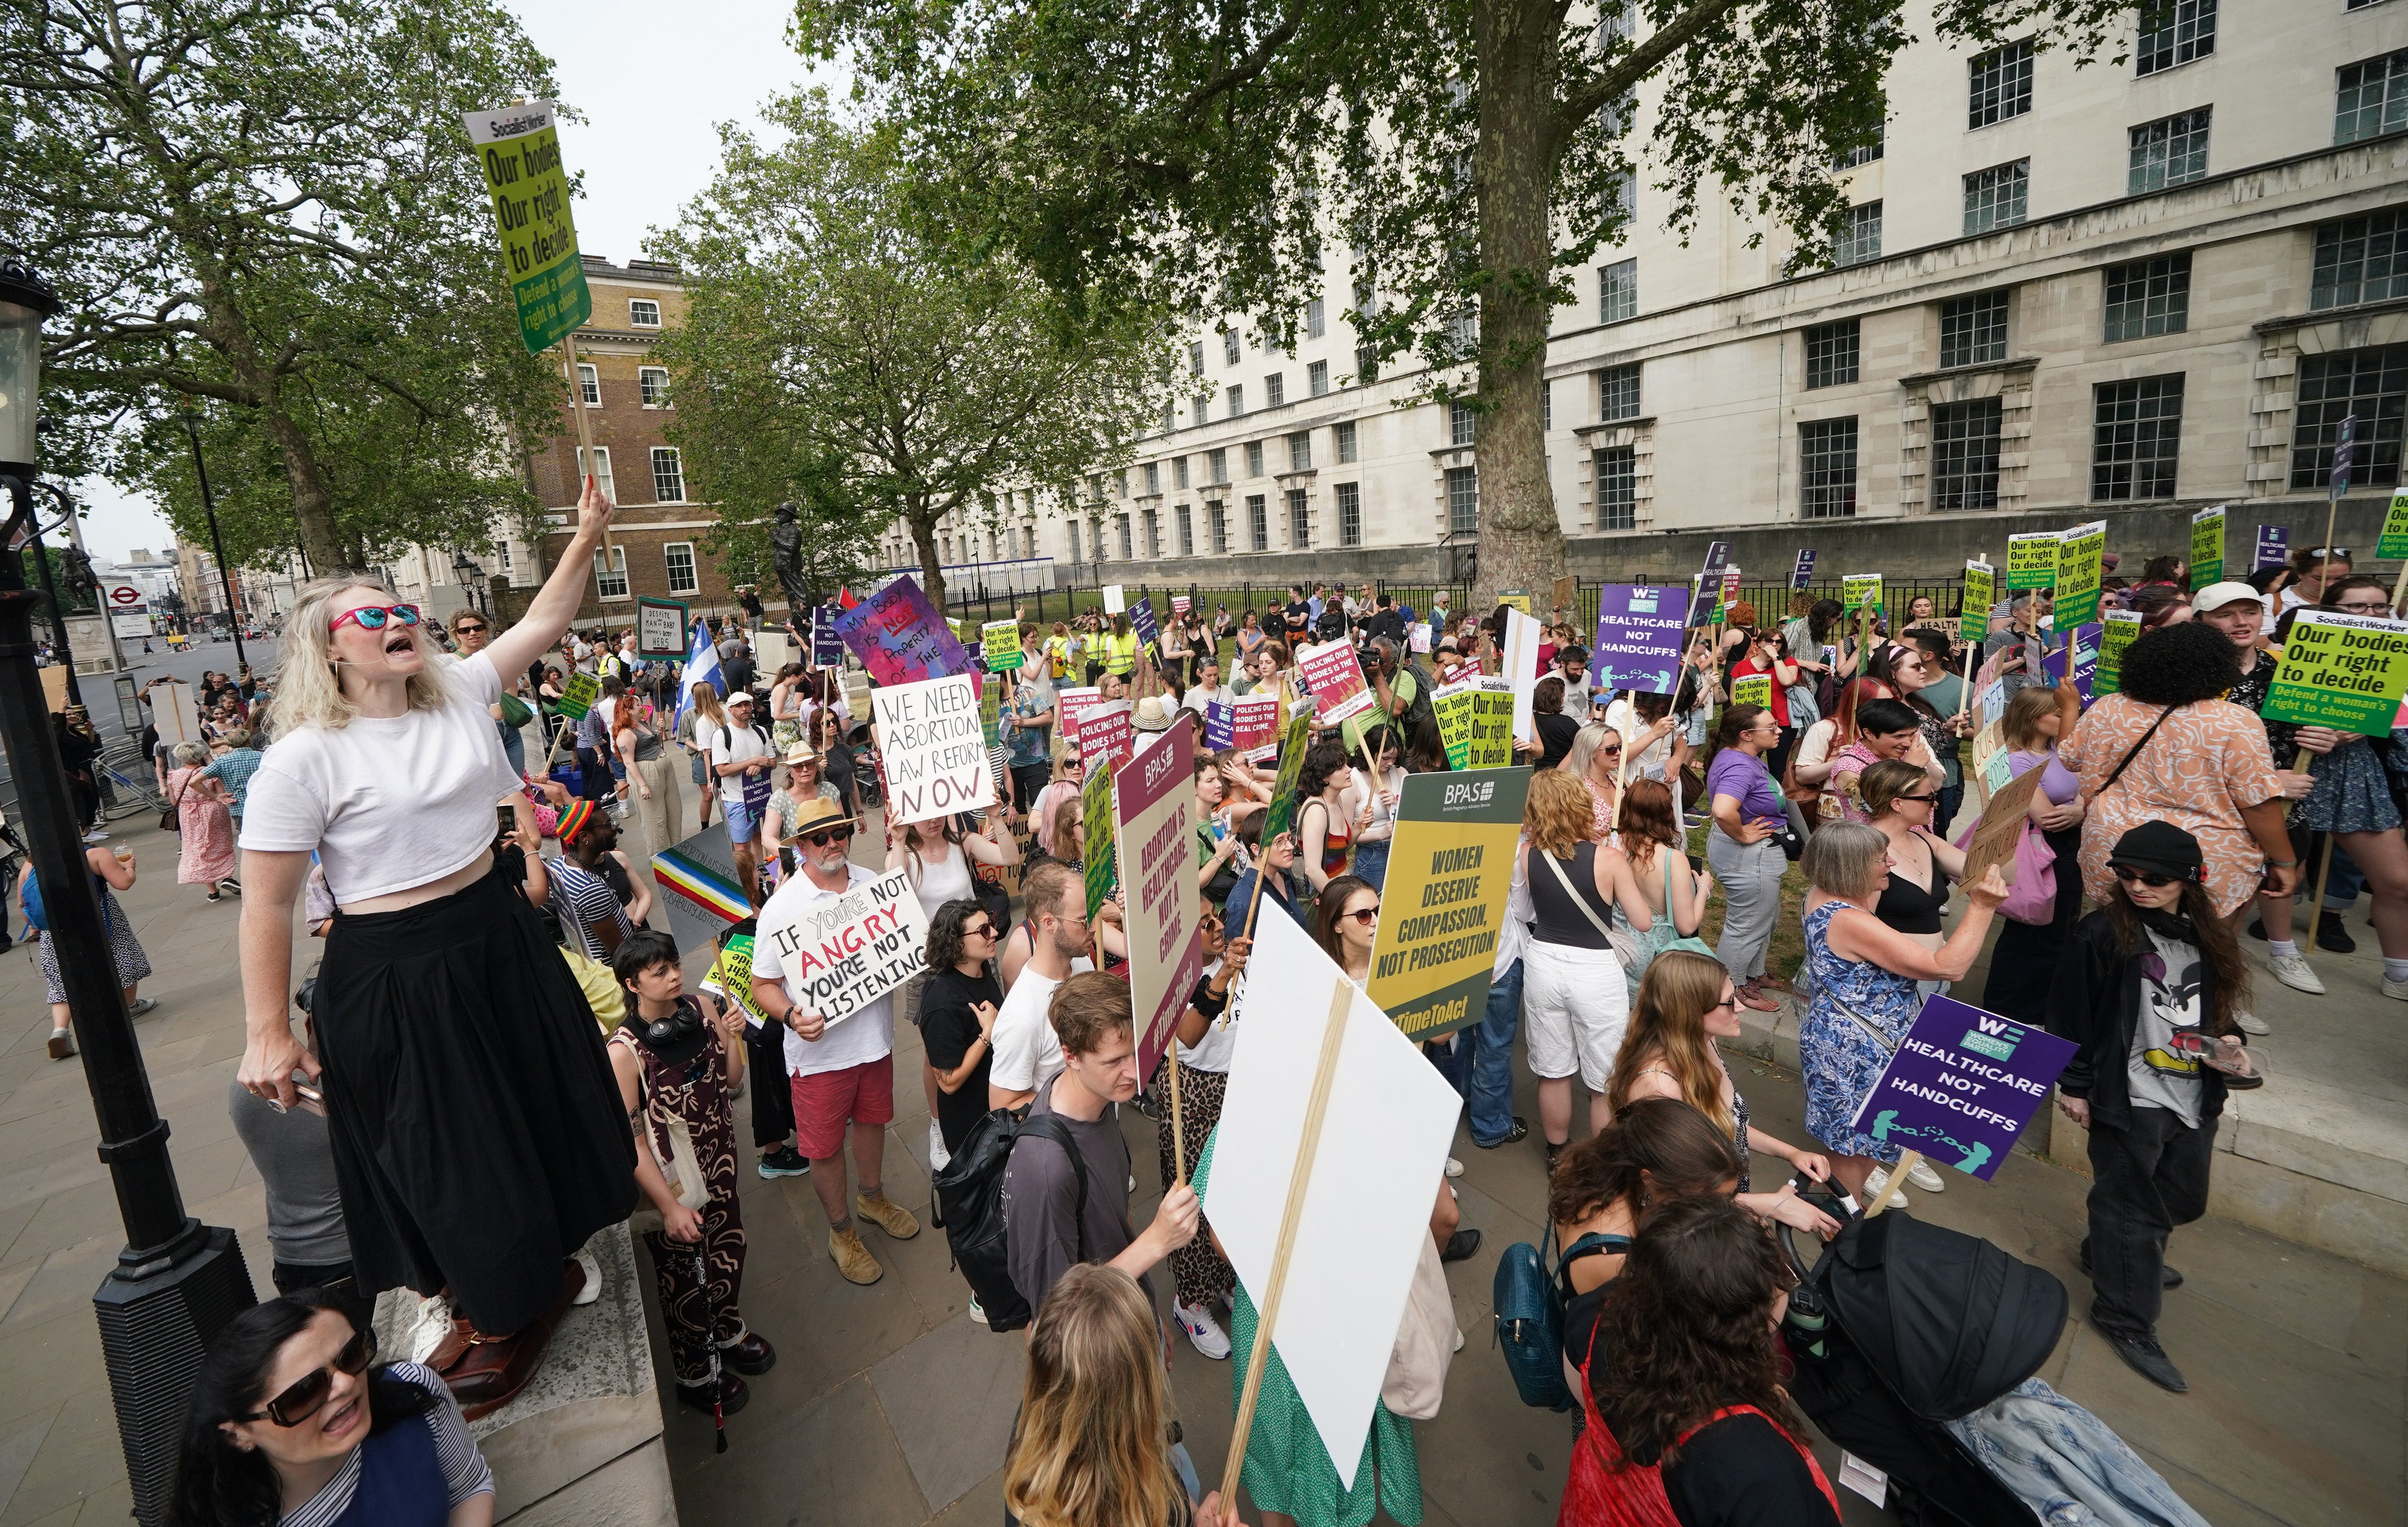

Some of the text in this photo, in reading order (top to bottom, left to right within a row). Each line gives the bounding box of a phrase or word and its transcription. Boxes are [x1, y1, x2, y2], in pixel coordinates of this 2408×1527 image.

[490, 113, 545, 138] Socialist Worker
[486, 135, 560, 187] Our bodies
[498, 179, 561, 231] Our right
[509, 222, 569, 275] to decide
[518, 282, 548, 306] Defend
[550, 278, 556, 292] a
[524, 306, 546, 331] right
[547, 303, 556, 317] to
[558, 288, 578, 313] choose
[2011, 540, 2059, 550] Our bodies
[2067, 526, 2099, 540] Socialist Worker
[2031, 550, 2053, 561] right
[2060, 537, 2102, 560] Our bodies
[2011, 559, 2053, 570] to decide
[2058, 555, 2095, 579] Our right
[2057, 574, 2094, 597] to decide
[864, 604, 912, 648] IS NOT
[998, 627, 1017, 635] bodies
[1600, 615, 1683, 629] HEALTHCARE
[1921, 621, 1957, 629] HEALTH
[2295, 624, 2335, 644] Our
[2316, 615, 2407, 632] Socialist Worker
[653, 638, 669, 647] HERS
[999, 636, 1014, 646] right
[1625, 630, 1652, 641] NOT
[997, 644, 1016, 653] decide
[1303, 648, 1349, 673] POLICING OUR
[1602, 642, 1677, 658] HANDCUFFS
[2288, 644, 2391, 673] Our right
[890, 645, 942, 685] OF THE
[1308, 667, 1333, 682] BODIES
[1339, 658, 1354, 669] THE
[569, 681, 591, 695] Our right
[573, 673, 597, 689] Our bodies
[1311, 680, 1330, 692] REAL
[1330, 670, 1351, 684] CRIME
[1481, 680, 1510, 691] Socialist Worker
[2281, 664, 2385, 694] to decide
[572, 692, 588, 703] decide
[881, 684, 971, 724] WE NEED
[1237, 705, 1262, 714] POLICING
[1473, 694, 1513, 715] Our bodies
[1984, 683, 2002, 723] OFF
[2270, 698, 2366, 721] right to choose
[2274, 685, 2388, 712] Defend a woman's
[887, 714, 979, 755] ABORTION
[1081, 715, 1125, 738] POLICING OUR
[1253, 723, 1268, 731] CRIME
[1472, 718, 1506, 744] Our right
[1082, 736, 1109, 753] BODIES
[1116, 729, 1128, 741] THE
[1974, 728, 1996, 767] OUR
[886, 740, 988, 786] LAW REFORM
[1471, 744, 1505, 764] to decide
[1145, 750, 1166, 788] BPAS
[743, 779, 771, 791] HEALTHCARE
[902, 767, 980, 816] NOW
[1444, 783, 1480, 804] BPAS
[746, 792, 771, 804] HANDCUFFS
[1141, 815, 1175, 877] ABORTION
[1176, 802, 1185, 831] IS
[677, 841, 738, 882] ABORTION JUSTICE IS
[1431, 844, 1485, 875] WOMEN
[1141, 834, 1188, 915] HEALTHCARE,
[1421, 875, 1481, 908] DESERVE
[662, 889, 722, 931] DISABILITY JUSTICE
[771, 924, 801, 959] IF
[870, 873, 908, 903] NOT
[1158, 880, 1179, 930] NOT A
[1397, 903, 1487, 944] COMPASSION,
[801, 903, 900, 980] ANGRY
[875, 924, 911, 957] NOT
[1159, 910, 1182, 964] CRIME
[1376, 929, 1496, 979] NOT PROSECUTION
[1153, 960, 1194, 1055] #TimeToAct
[1966, 1037, 2008, 1054] EQUALITY
[1970, 1032, 2009, 1050] WOMEN'S
[1904, 1037, 2047, 1098] HEALTHCARE
[1937, 1072, 1986, 1096] NOT
[1890, 1077, 2019, 1133] HANDCUFFS
